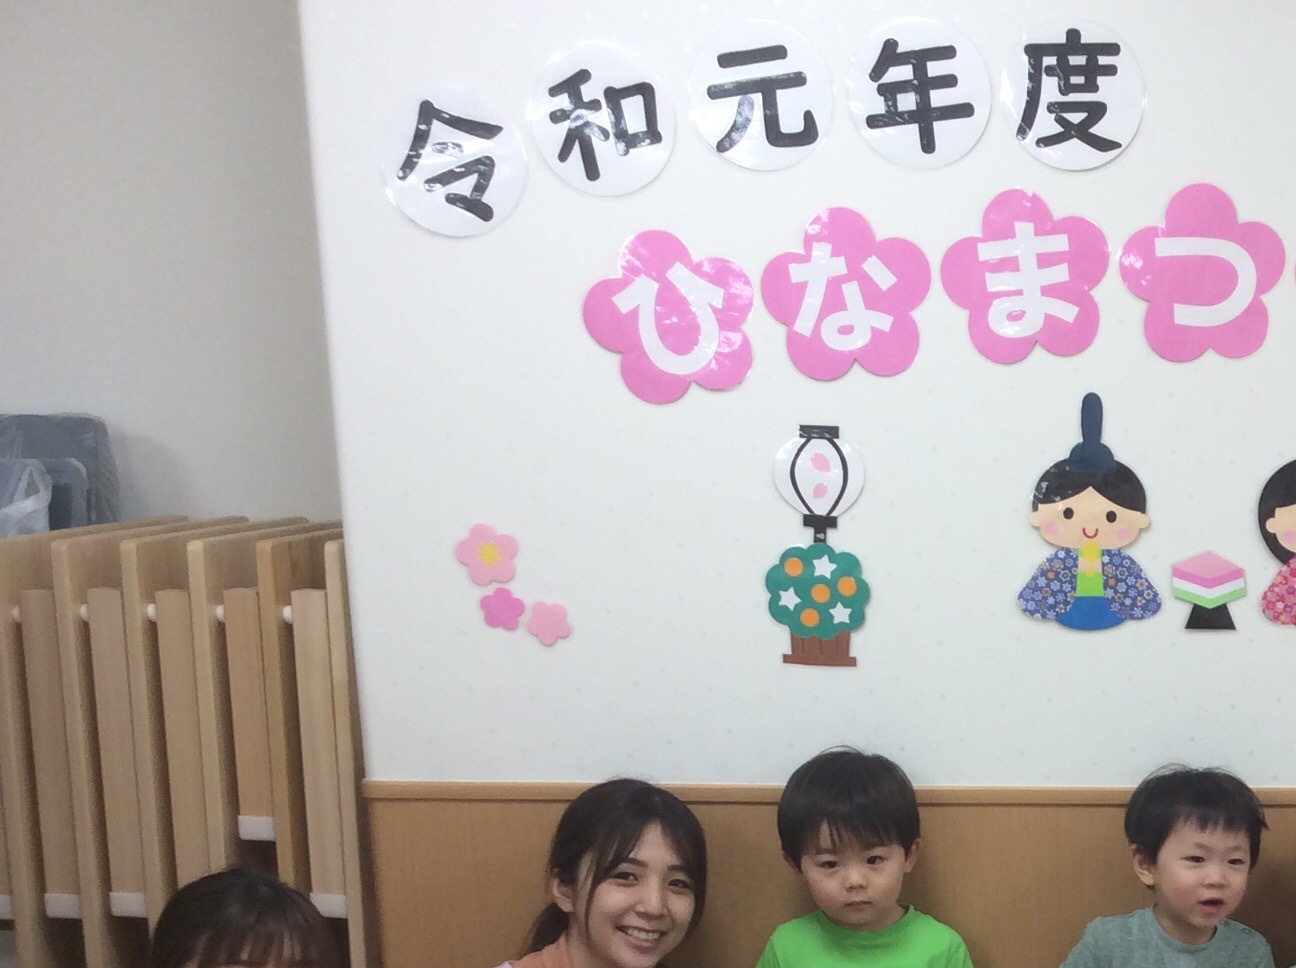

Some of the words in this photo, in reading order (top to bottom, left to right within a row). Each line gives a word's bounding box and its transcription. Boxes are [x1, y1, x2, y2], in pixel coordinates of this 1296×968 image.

[396, 28, 1123, 222] 令和元年度
